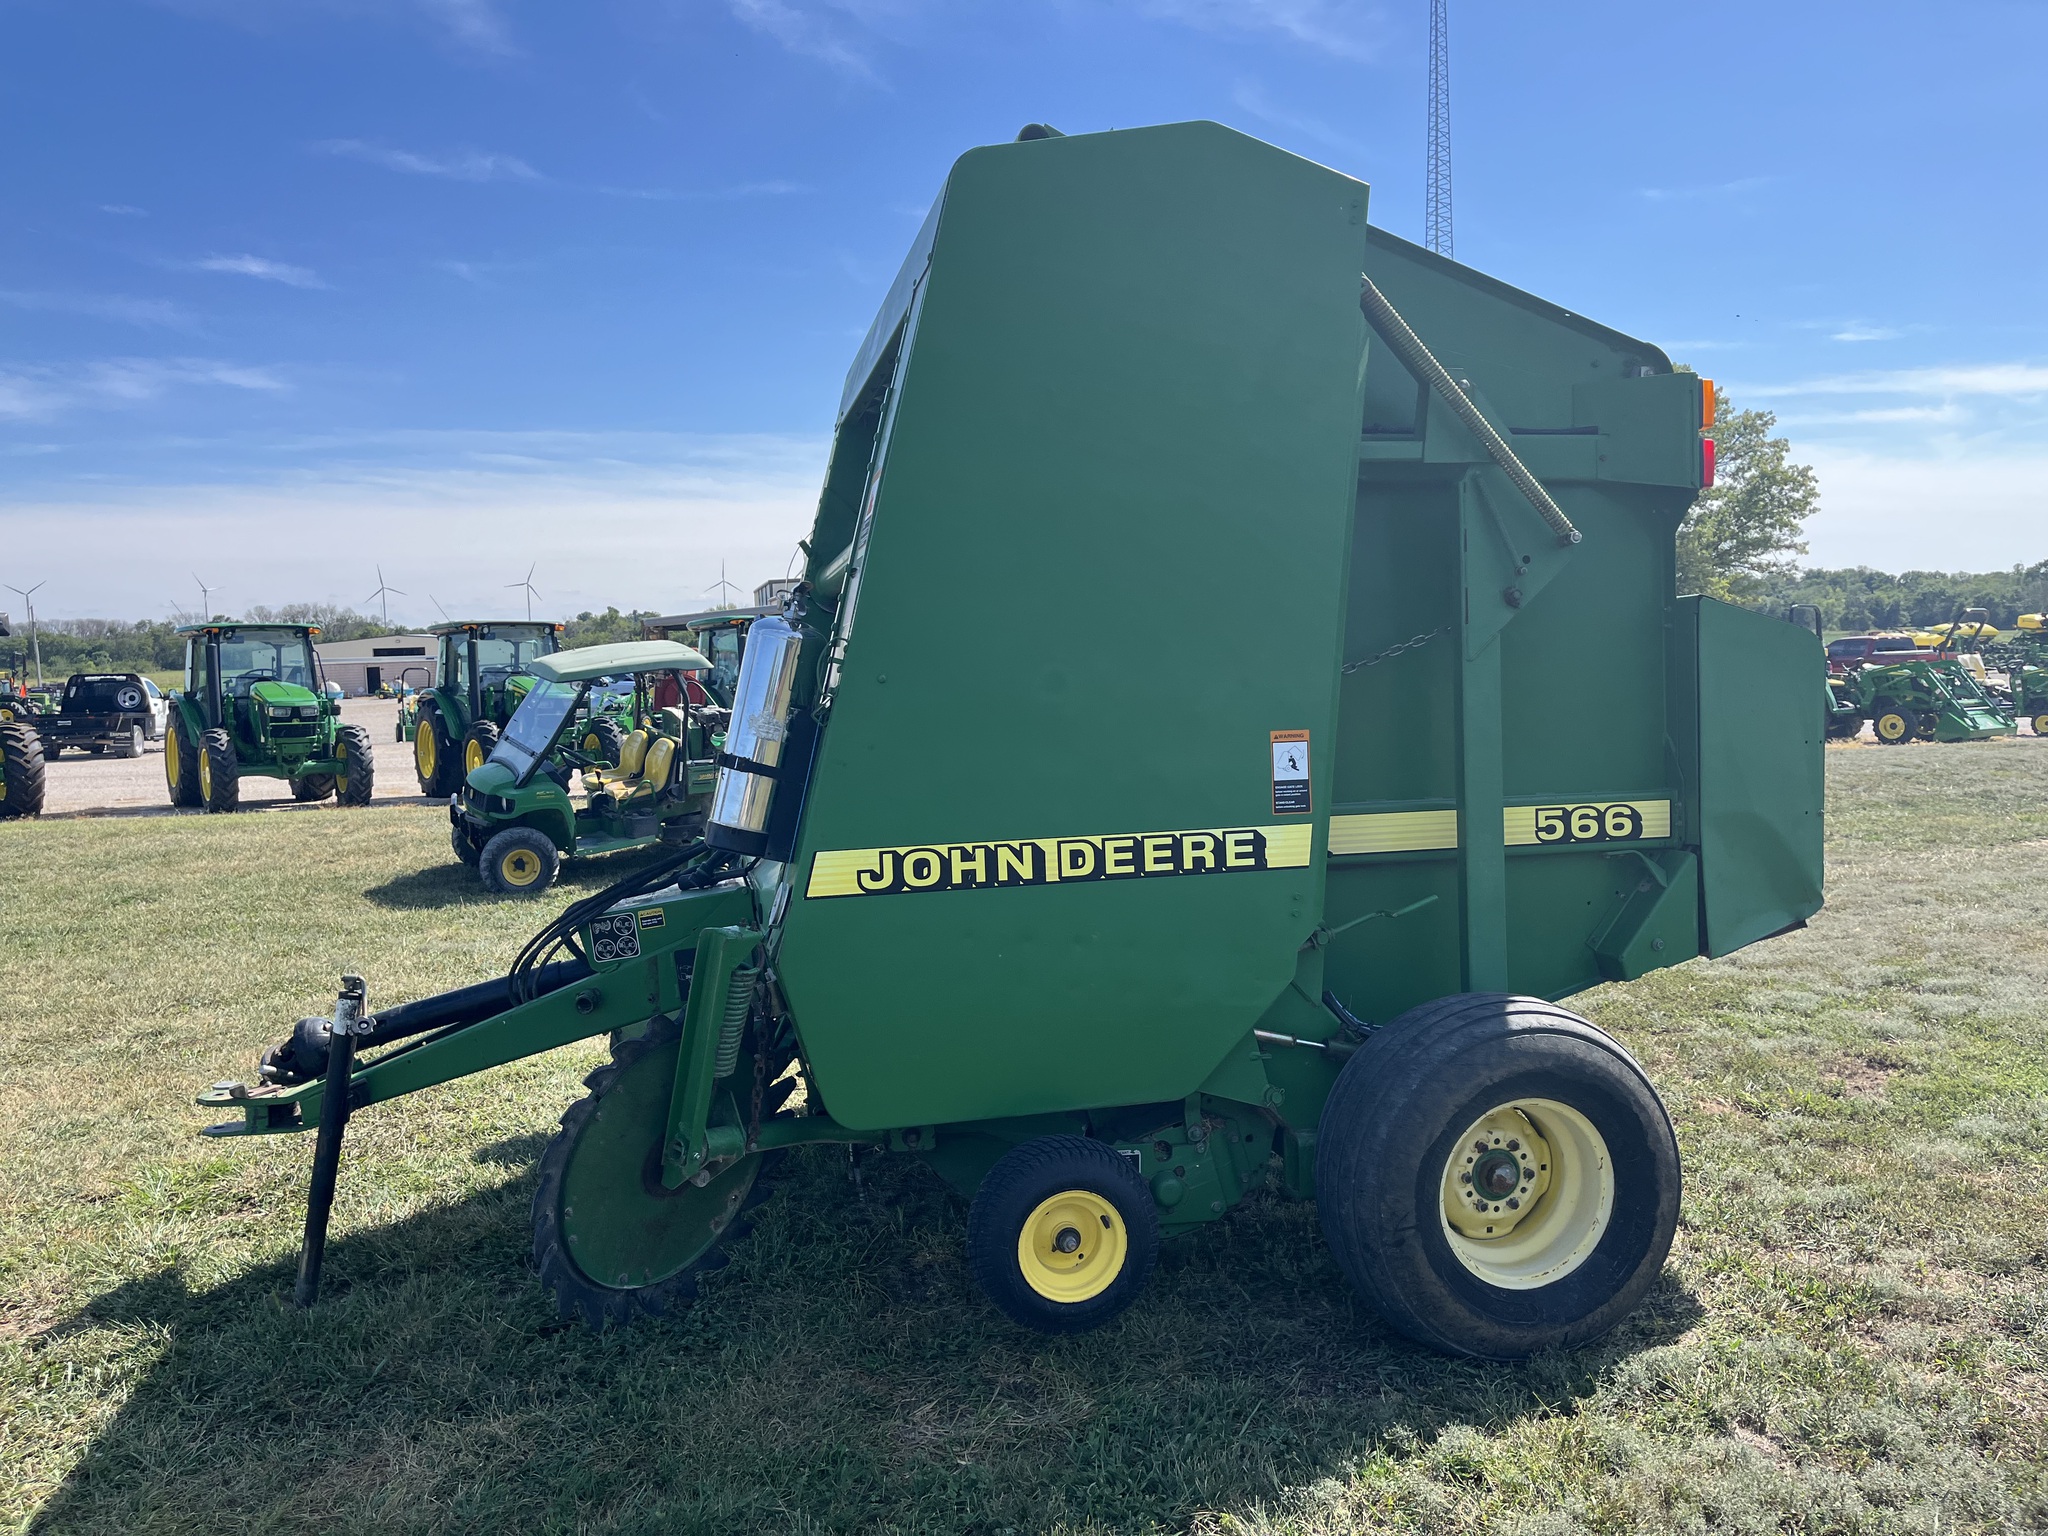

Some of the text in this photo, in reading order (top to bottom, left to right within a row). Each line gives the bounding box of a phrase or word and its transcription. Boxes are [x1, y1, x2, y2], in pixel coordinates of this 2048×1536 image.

[1536, 805, 1640, 842] 566
[858, 831, 1263, 891] JOHN DEERE
